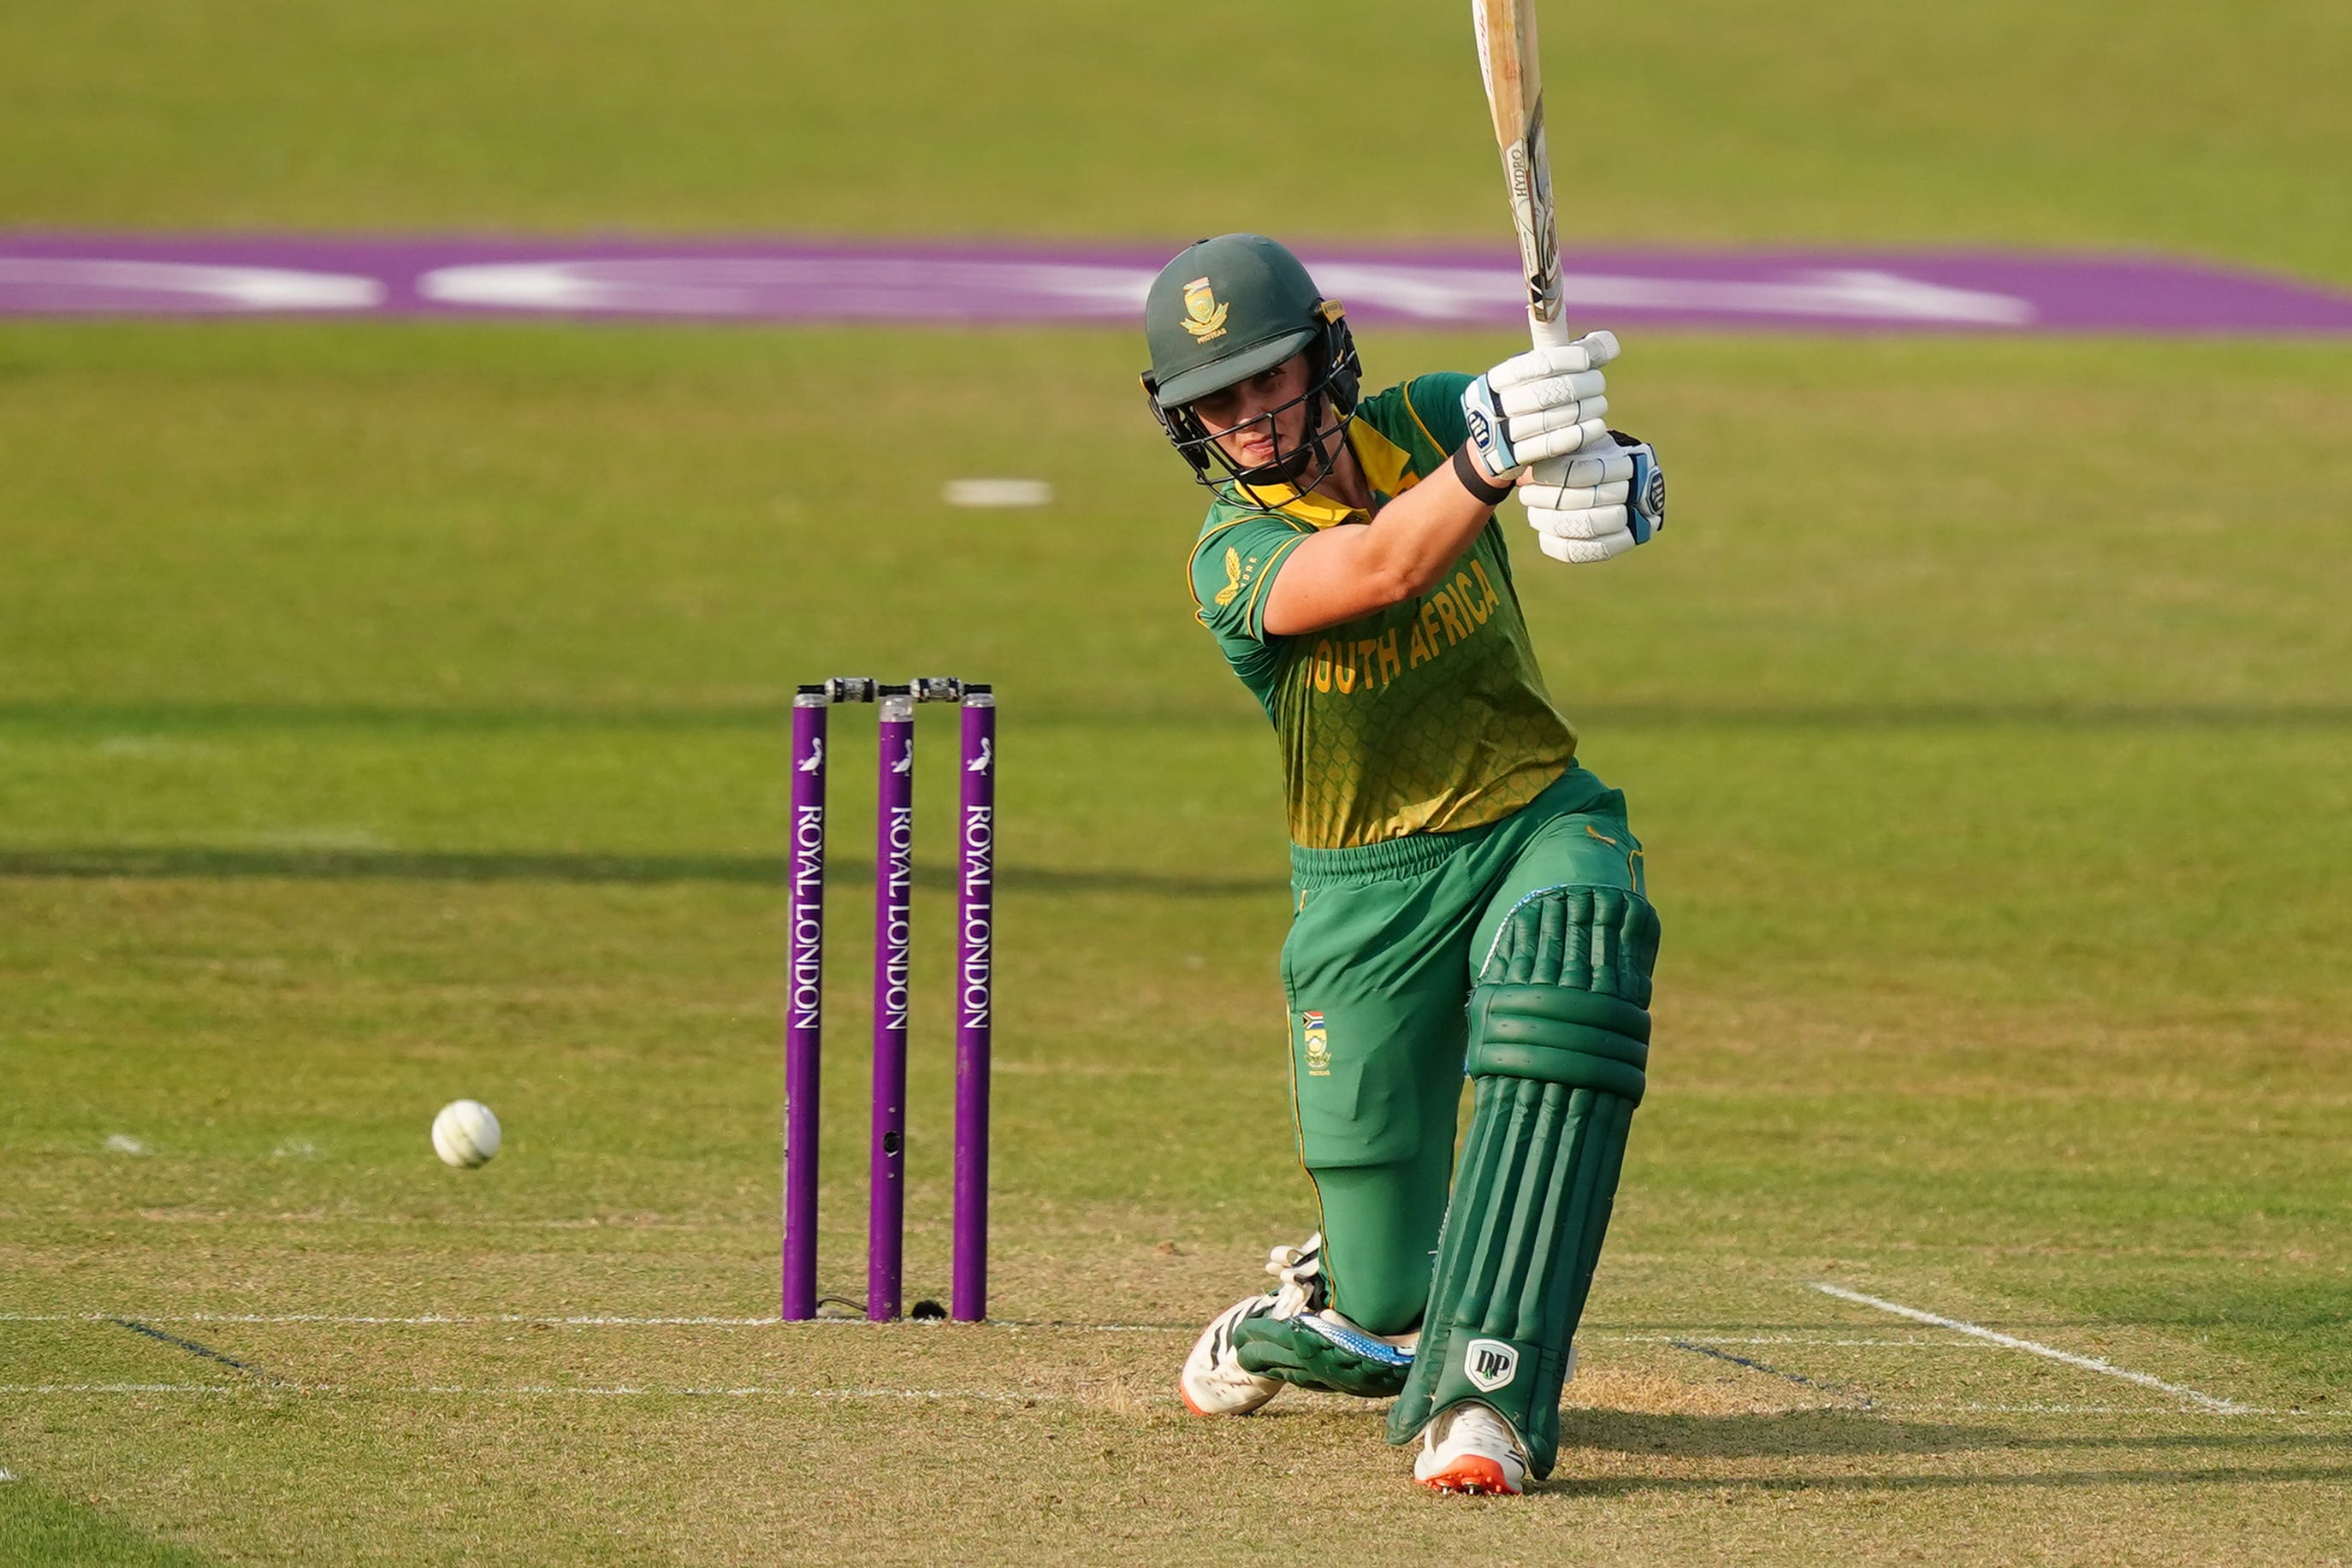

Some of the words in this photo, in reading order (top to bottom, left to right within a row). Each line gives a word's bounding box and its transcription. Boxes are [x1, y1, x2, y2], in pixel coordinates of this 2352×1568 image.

[1511, 149, 1528, 198] HYDRO
[1305, 629, 1401, 695] OUTH
[1410, 559, 1500, 669] AFRICA
[797, 805, 822, 897] ROYAL
[889, 807, 911, 898] ROYAL
[965, 805, 992, 896] ROYAL
[794, 903, 821, 1029] LONDON
[886, 905, 909, 1031] LONDON
[963, 903, 991, 1029] LONDON
